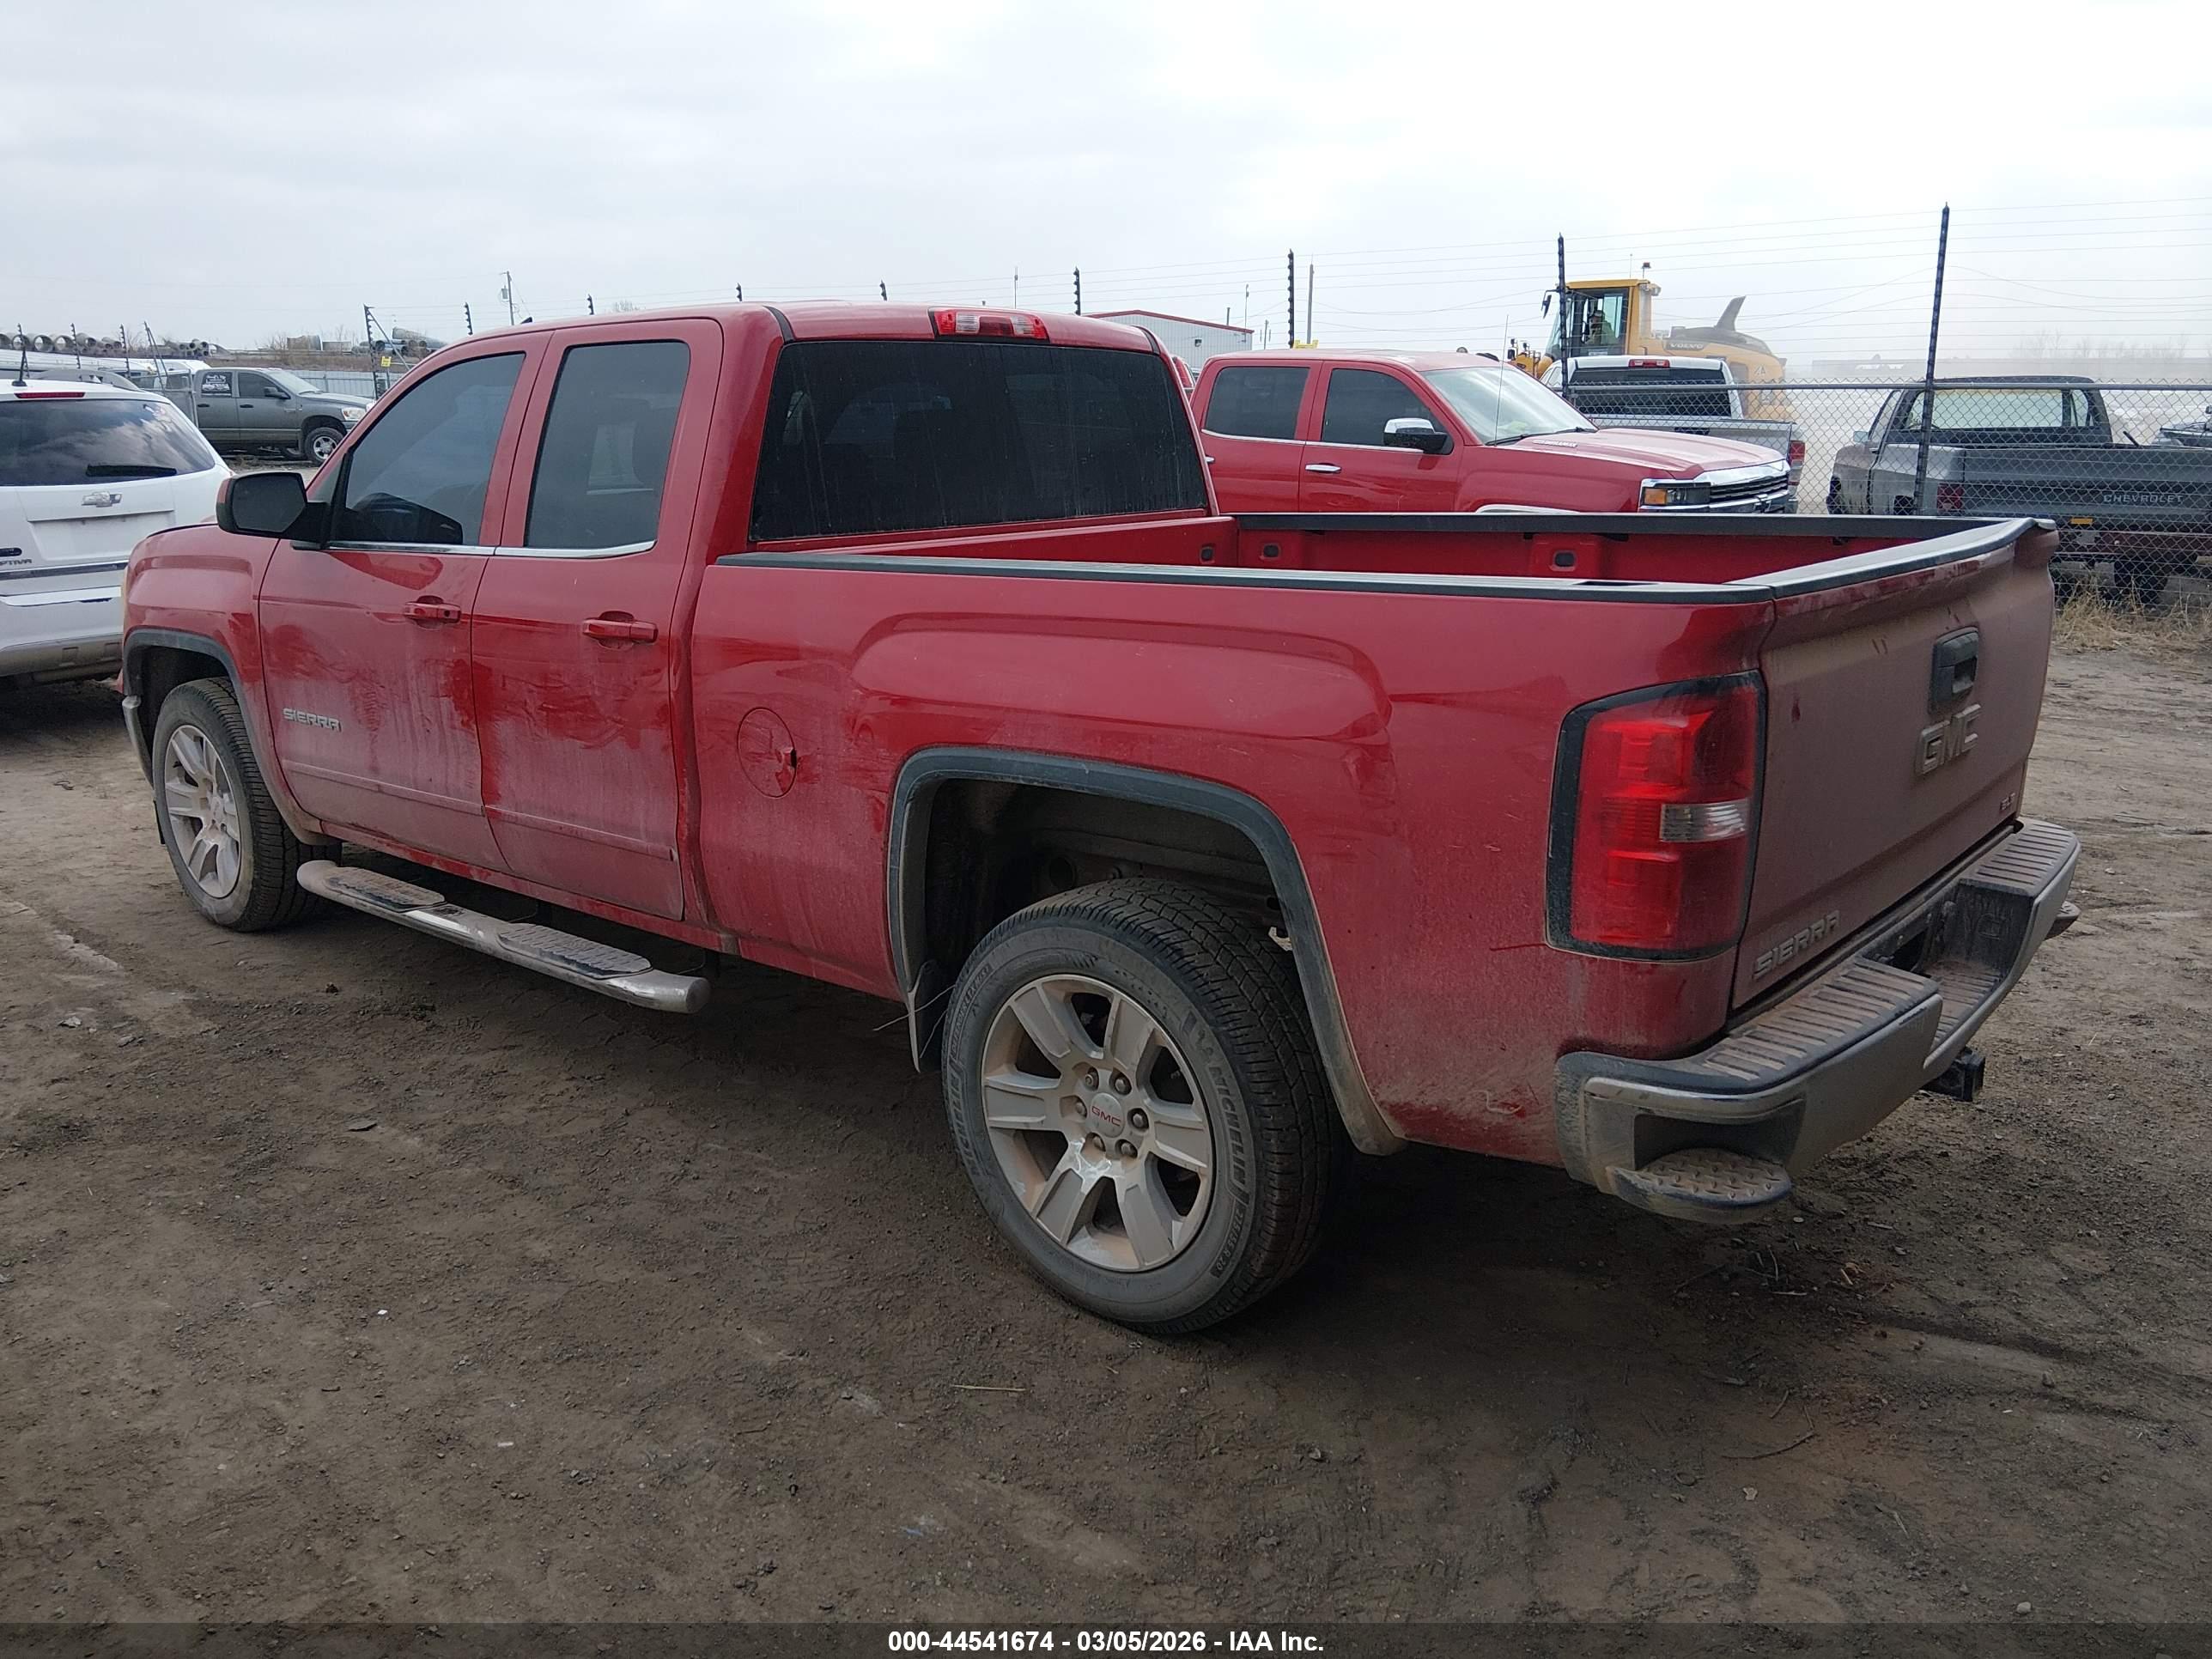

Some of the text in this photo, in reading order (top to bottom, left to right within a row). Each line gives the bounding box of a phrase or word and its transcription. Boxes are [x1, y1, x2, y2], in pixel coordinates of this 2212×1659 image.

[2102, 494, 2185, 503] CHEVROLET
[283, 708, 342, 732] SIERRA
[1916, 703, 1981, 775] GMC
[1753, 910, 1840, 980] SIERRA
[1091, 1105, 1121, 1127] GMC
[1209, 1066, 1246, 1185] MICHELIN
[1226, 1207, 1244, 1249] 275/55
[1216, 1256, 1227, 1271] 20
